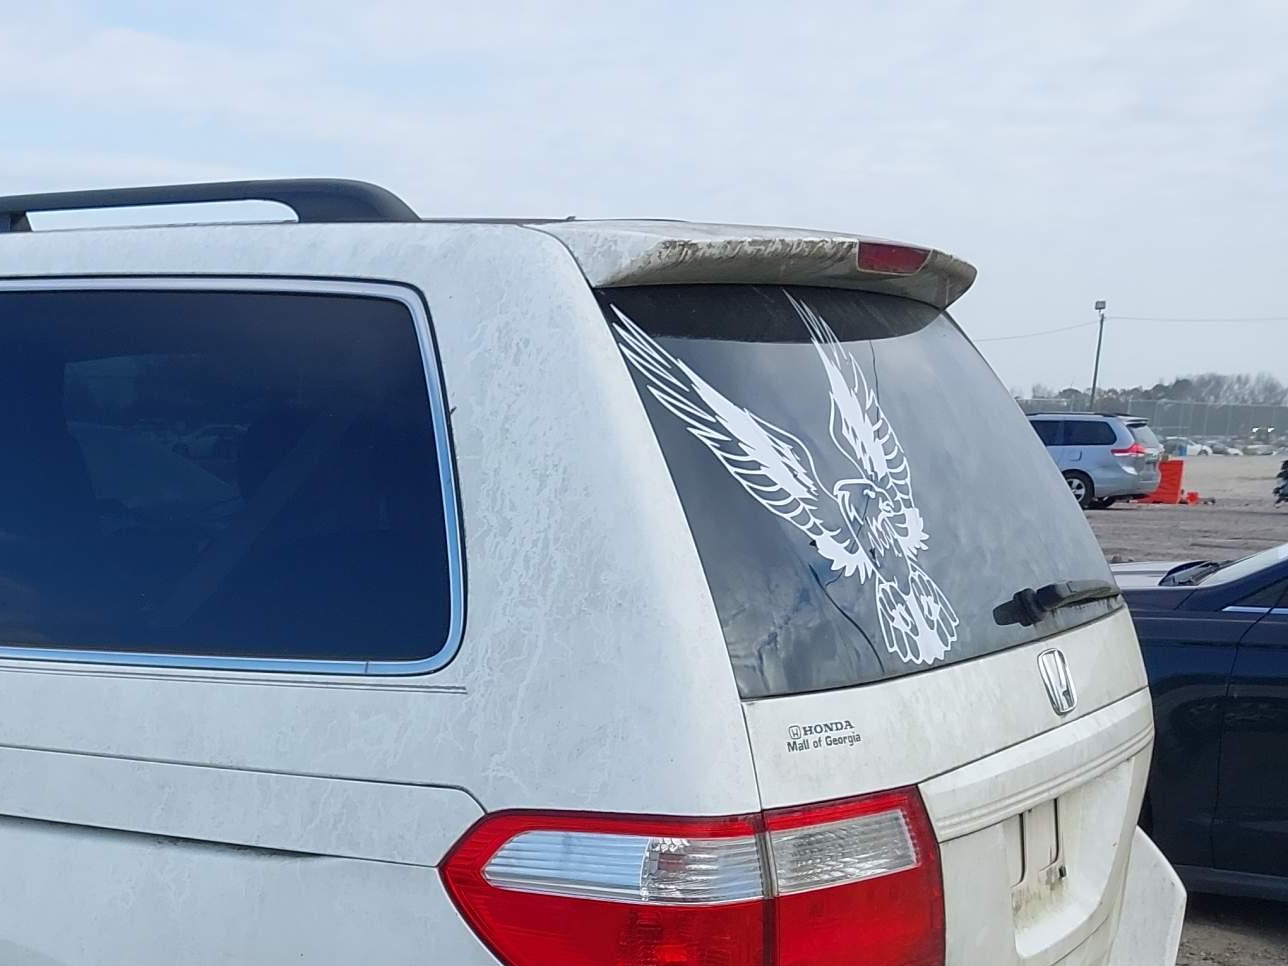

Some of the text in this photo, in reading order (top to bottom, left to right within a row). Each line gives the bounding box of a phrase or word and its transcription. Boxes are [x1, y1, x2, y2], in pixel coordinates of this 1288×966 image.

[801, 720, 855, 736] HONDA
[786, 731, 862, 752] Mall of Georgia
